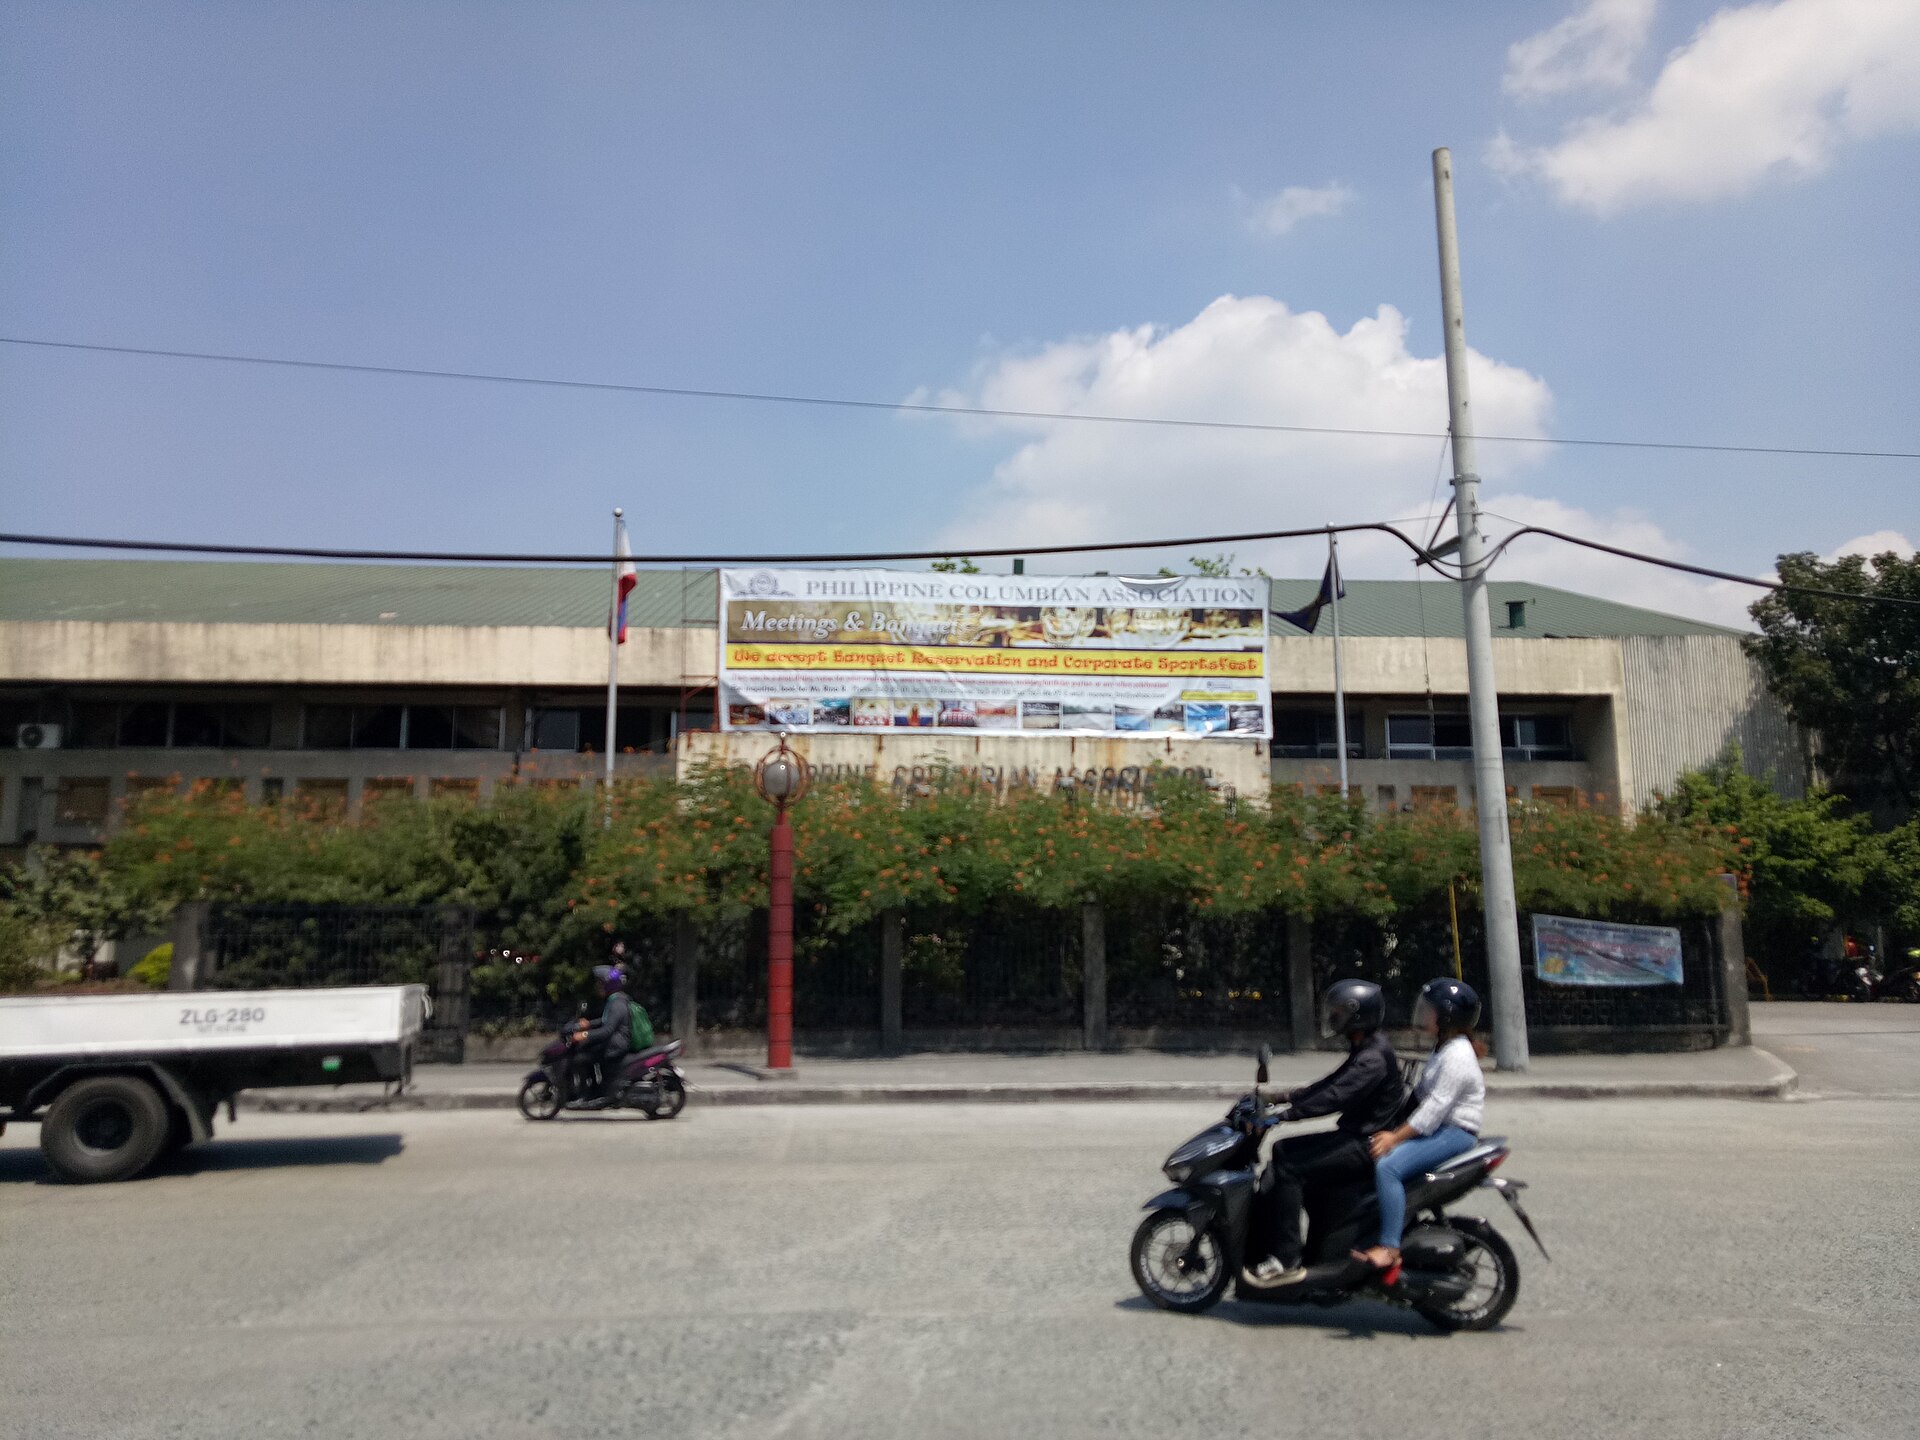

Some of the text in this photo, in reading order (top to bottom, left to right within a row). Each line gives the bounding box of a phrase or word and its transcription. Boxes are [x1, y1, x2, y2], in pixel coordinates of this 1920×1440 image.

[806, 580, 1256, 602] PHILIPPINE COLUMBIAN ASSOCIATION
[741, 609, 838, 638] Meetings
[843, 611, 865, 632] &
[766, 650, 827, 666] accept
[833, 649, 904, 666] Banquet
[911, 651, 1021, 668] Reservation
[1027, 653, 1059, 668] and
[1063, 654, 1152, 672] Corporate
[1158, 655, 1257, 673] Sportsfest
